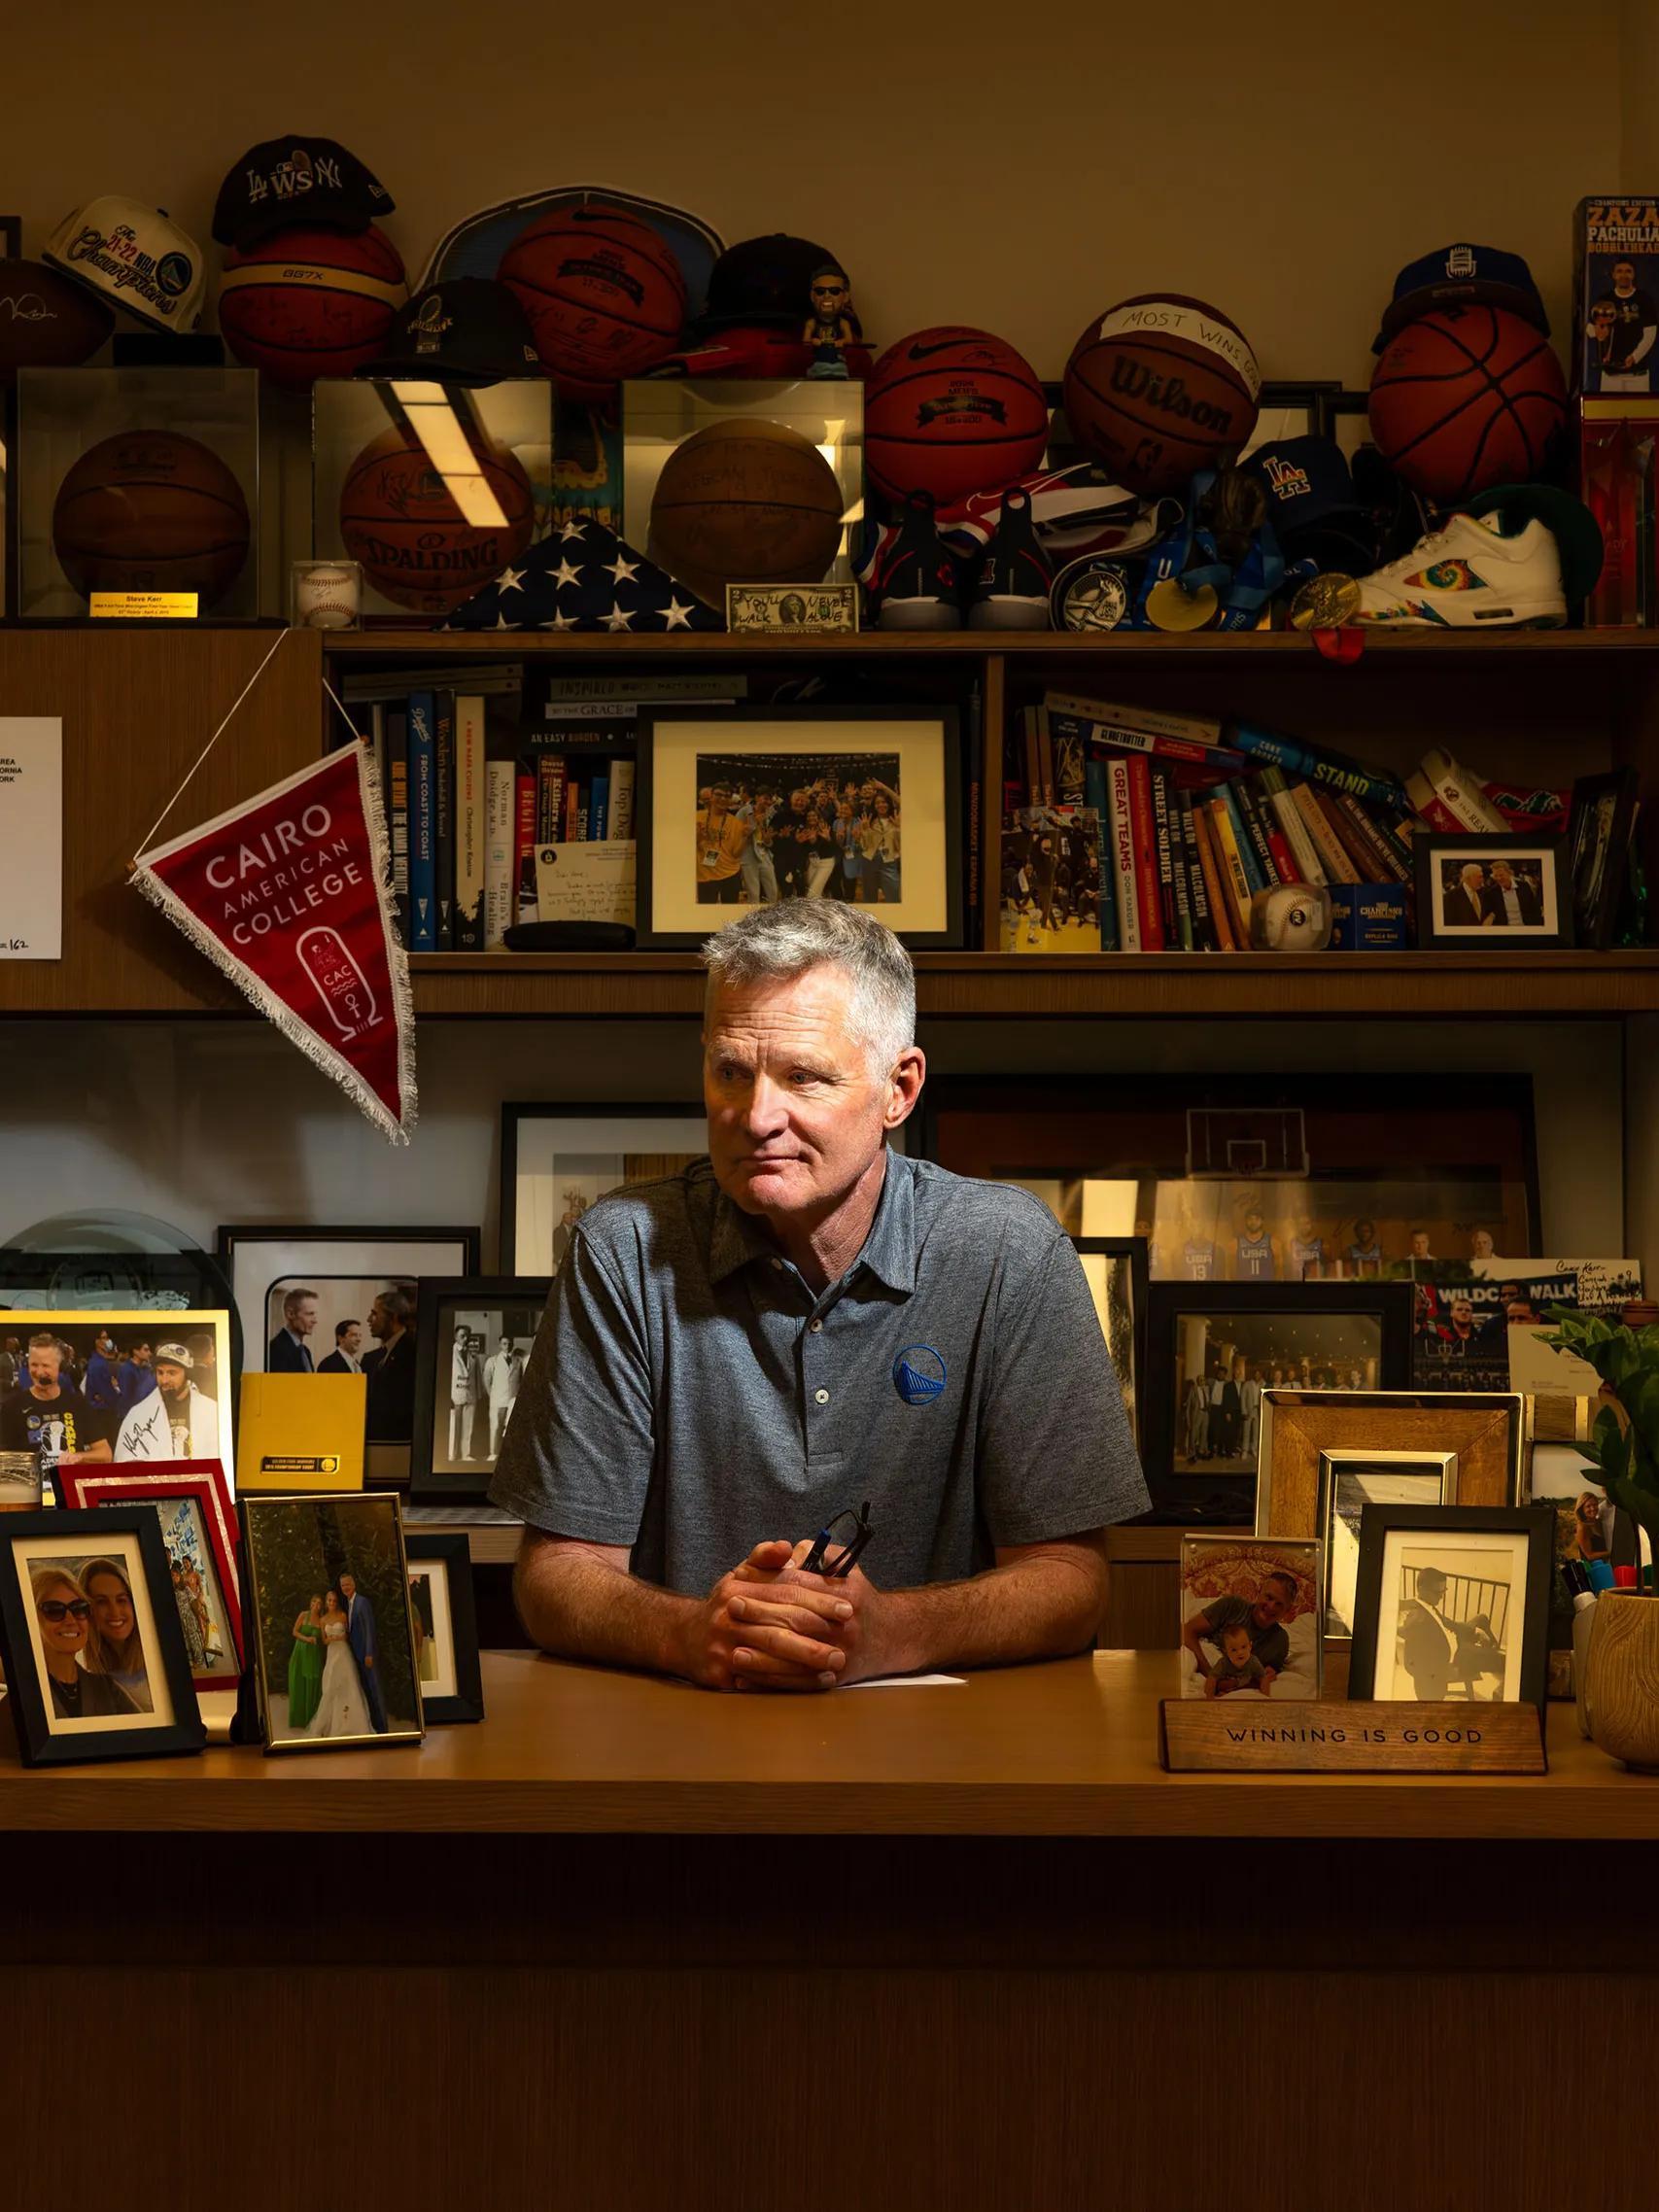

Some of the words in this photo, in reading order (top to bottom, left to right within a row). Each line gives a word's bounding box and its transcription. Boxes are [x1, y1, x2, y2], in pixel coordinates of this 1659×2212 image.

[247, 169, 268, 203] LA
[271, 171, 313, 195] WS
[315, 158, 342, 188] NY
[1587, 207, 1659, 226] ZAZA
[1587, 226, 1659, 242] PACHULIA
[66, 226, 178, 316] Champions
[107, 235, 134, 263] 21-22
[134, 252, 156, 276] NBA
[1123, 310, 1189, 328] MOST
[1198, 323, 1242, 361] WINS
[1110, 355, 1232, 435] Wilson
[1262, 455, 1311, 500] LA
[365, 536, 498, 571] SPALDING
[739, 613, 772, 624] WALK
[805, 611, 843, 623] ALONE
[580, 703, 624, 716] GRACE
[437, 717, 451, 767] Wooden
[544, 733, 566, 743] EASY
[420, 754, 429, 780] FROM
[1313, 763, 1370, 796] STAND
[420, 781, 429, 812] COAST
[500, 780, 510, 826] Norman
[614, 786, 632, 811] Top
[1114, 767, 1128, 817] GREAT
[1154, 775, 1167, 825] STREET
[420, 815, 429, 828] TO
[613, 812, 630, 841] Dog
[1170, 830, 1181, 843] ON
[1183, 811, 1194, 832] WALK
[206, 804, 331, 889] CAIRO
[393, 826, 408, 855] MAMBA
[420, 830, 430, 861] COAST
[1117, 821, 1131, 872] TEAMS
[1185, 832, 1196, 845] ON
[1251, 822, 1269, 857] PERFECT
[1158, 827, 1172, 884] SOLDIER
[224, 838, 350, 919] AMERICAN
[1173, 861, 1190, 916] MALCOLMSON
[1190, 864, 1208, 918] MALCOLMSON
[231, 861, 363, 946] COLLEGE
[10, 939, 28, 951] 162
[323, 964, 353, 986] CAC
[1241, 1249, 1268, 1260] USA
[1251, 1260, 1261, 1276] 11
[1295, 1250, 1321, 1262] USA
[1192, 1264, 1206, 1281] 13
[1438, 1286, 1501, 1303] WILDC
[1227, 1728, 1347, 1743] WINNING
[1363, 1728, 1387, 1743] IS
[1402, 1728, 1482, 1743] GOOD
